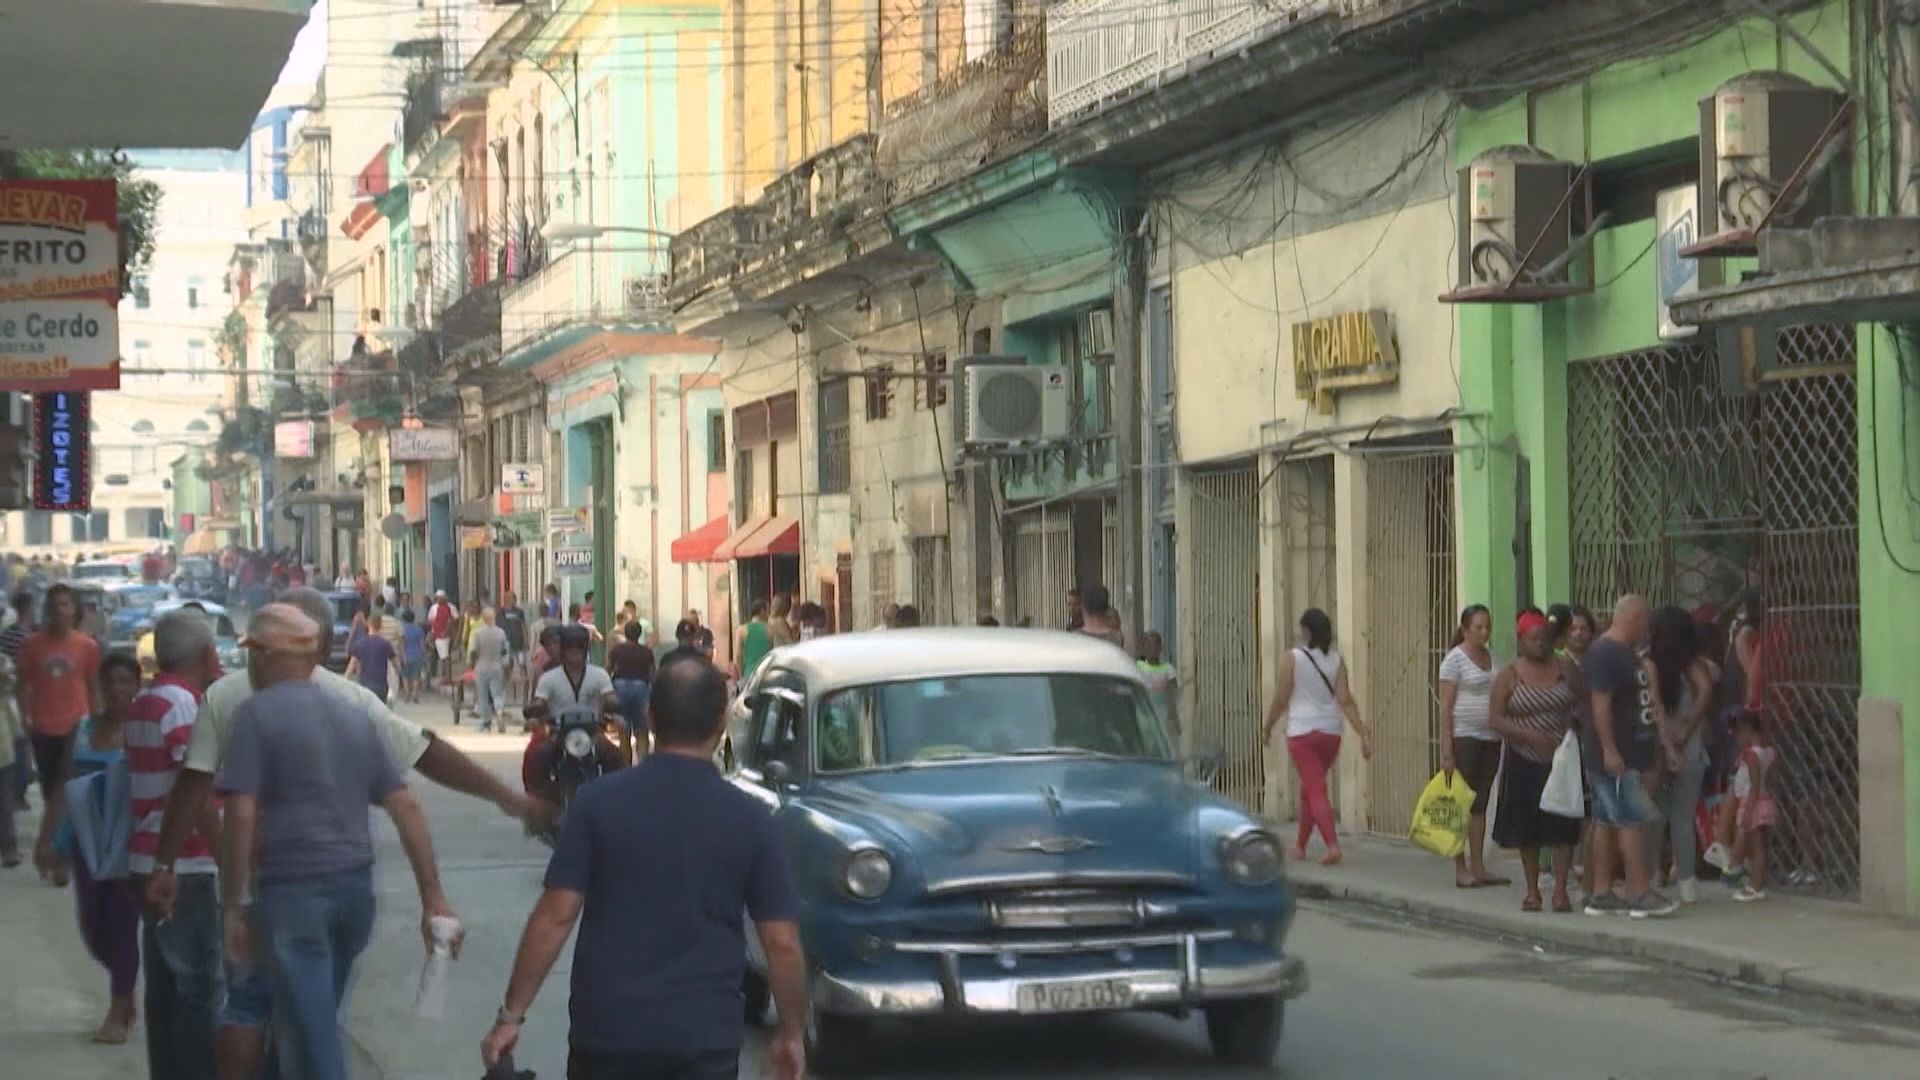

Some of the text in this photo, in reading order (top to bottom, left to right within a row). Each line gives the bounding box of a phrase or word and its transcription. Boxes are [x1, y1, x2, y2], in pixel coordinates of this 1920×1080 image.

[25, 312, 98, 338] Cerdo
[1311, 312, 1351, 371] GRAN
[555, 550, 592, 567] JOYERO
